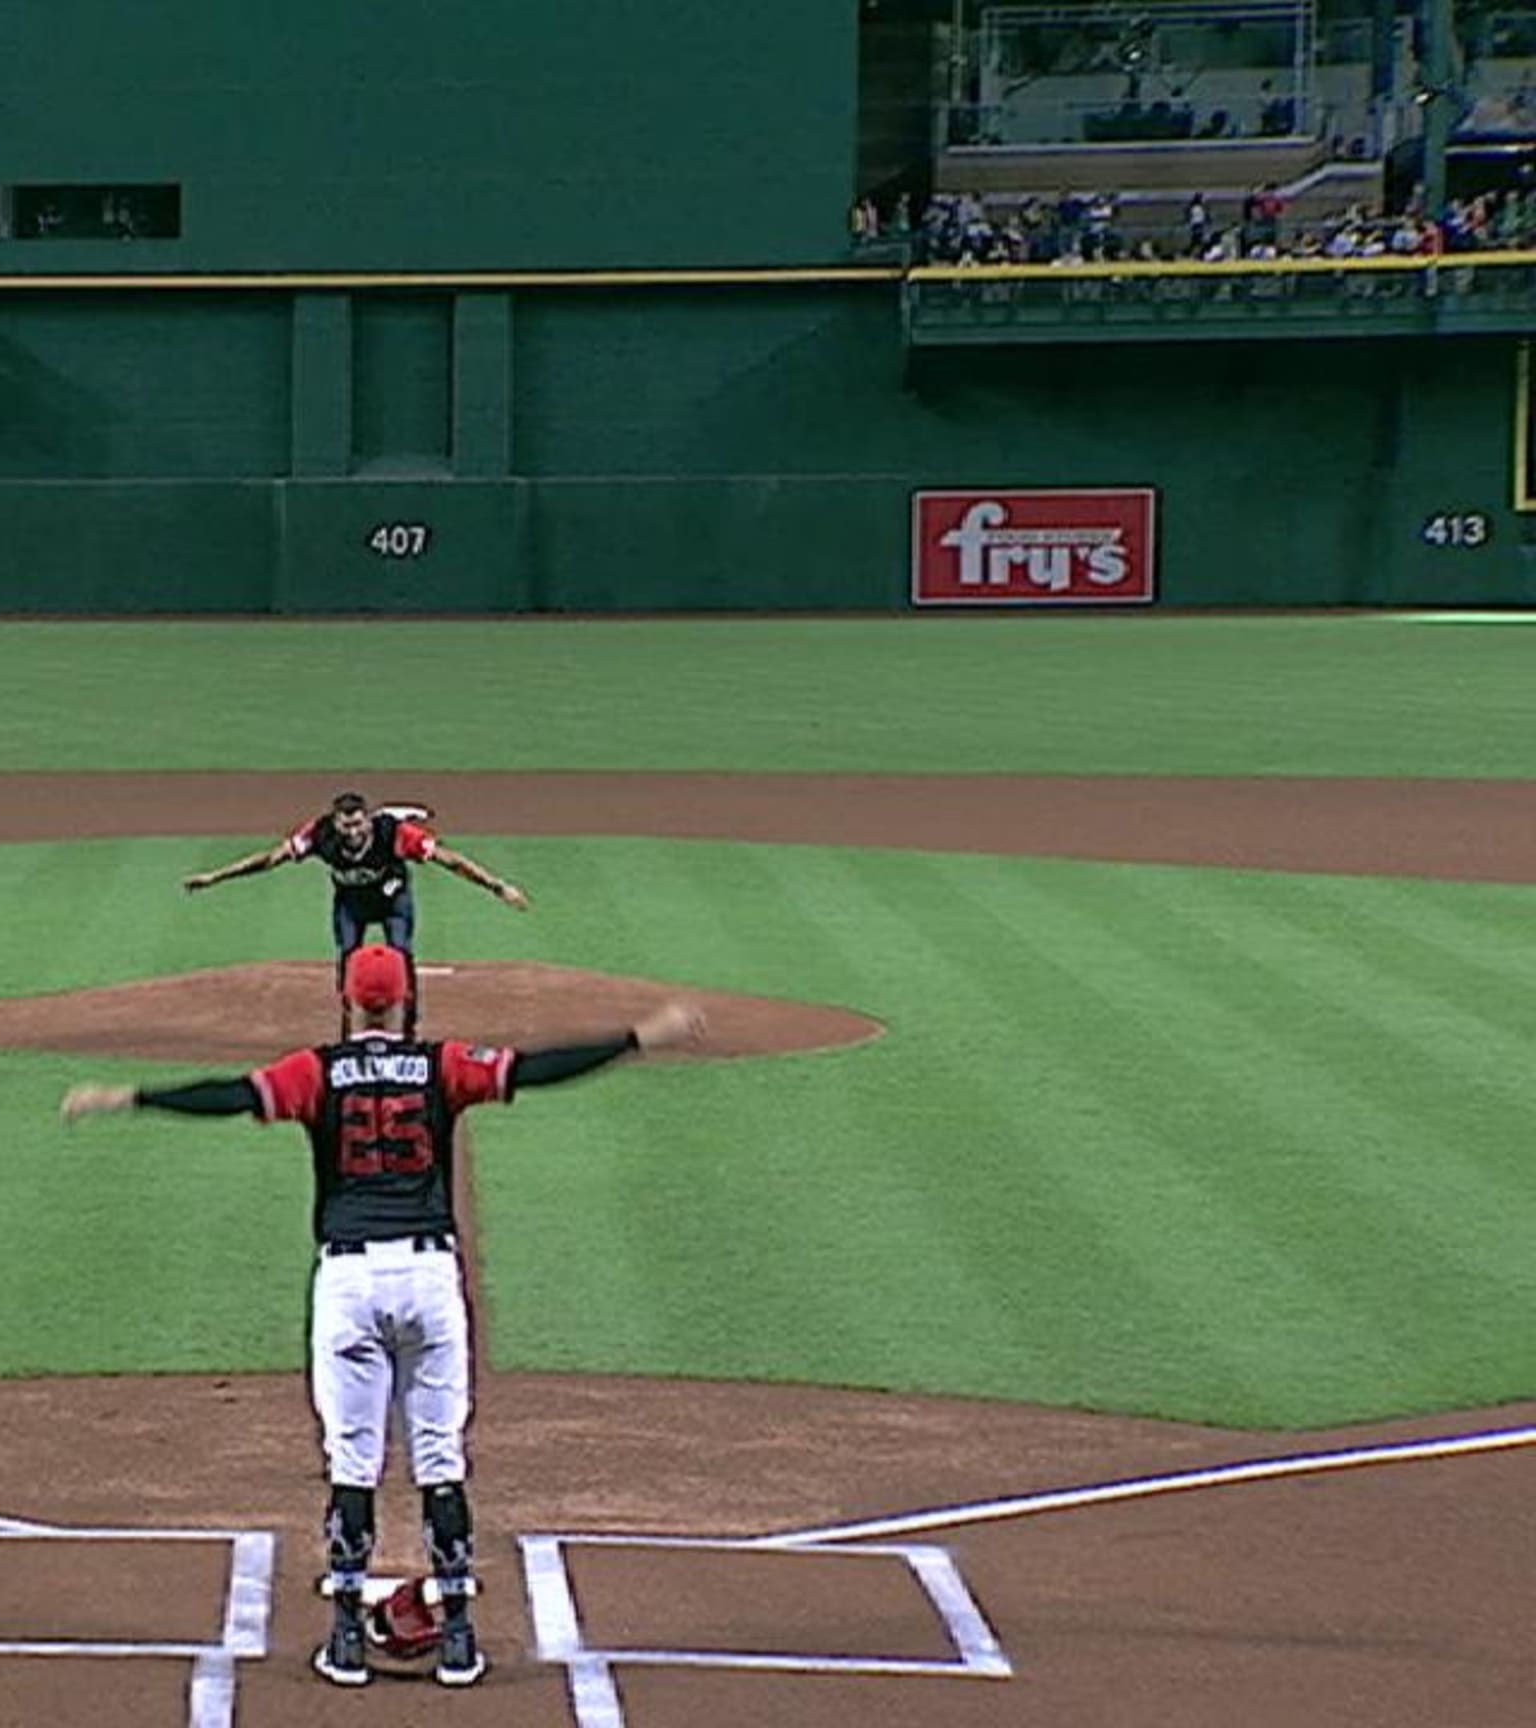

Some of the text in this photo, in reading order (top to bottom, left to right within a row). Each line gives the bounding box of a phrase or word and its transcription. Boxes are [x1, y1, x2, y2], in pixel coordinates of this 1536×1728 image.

[370, 525, 426, 555] 407
[939, 501, 1129, 591] fry's
[1424, 515, 1486, 545] 413
[339, 1093, 434, 1174] 25
